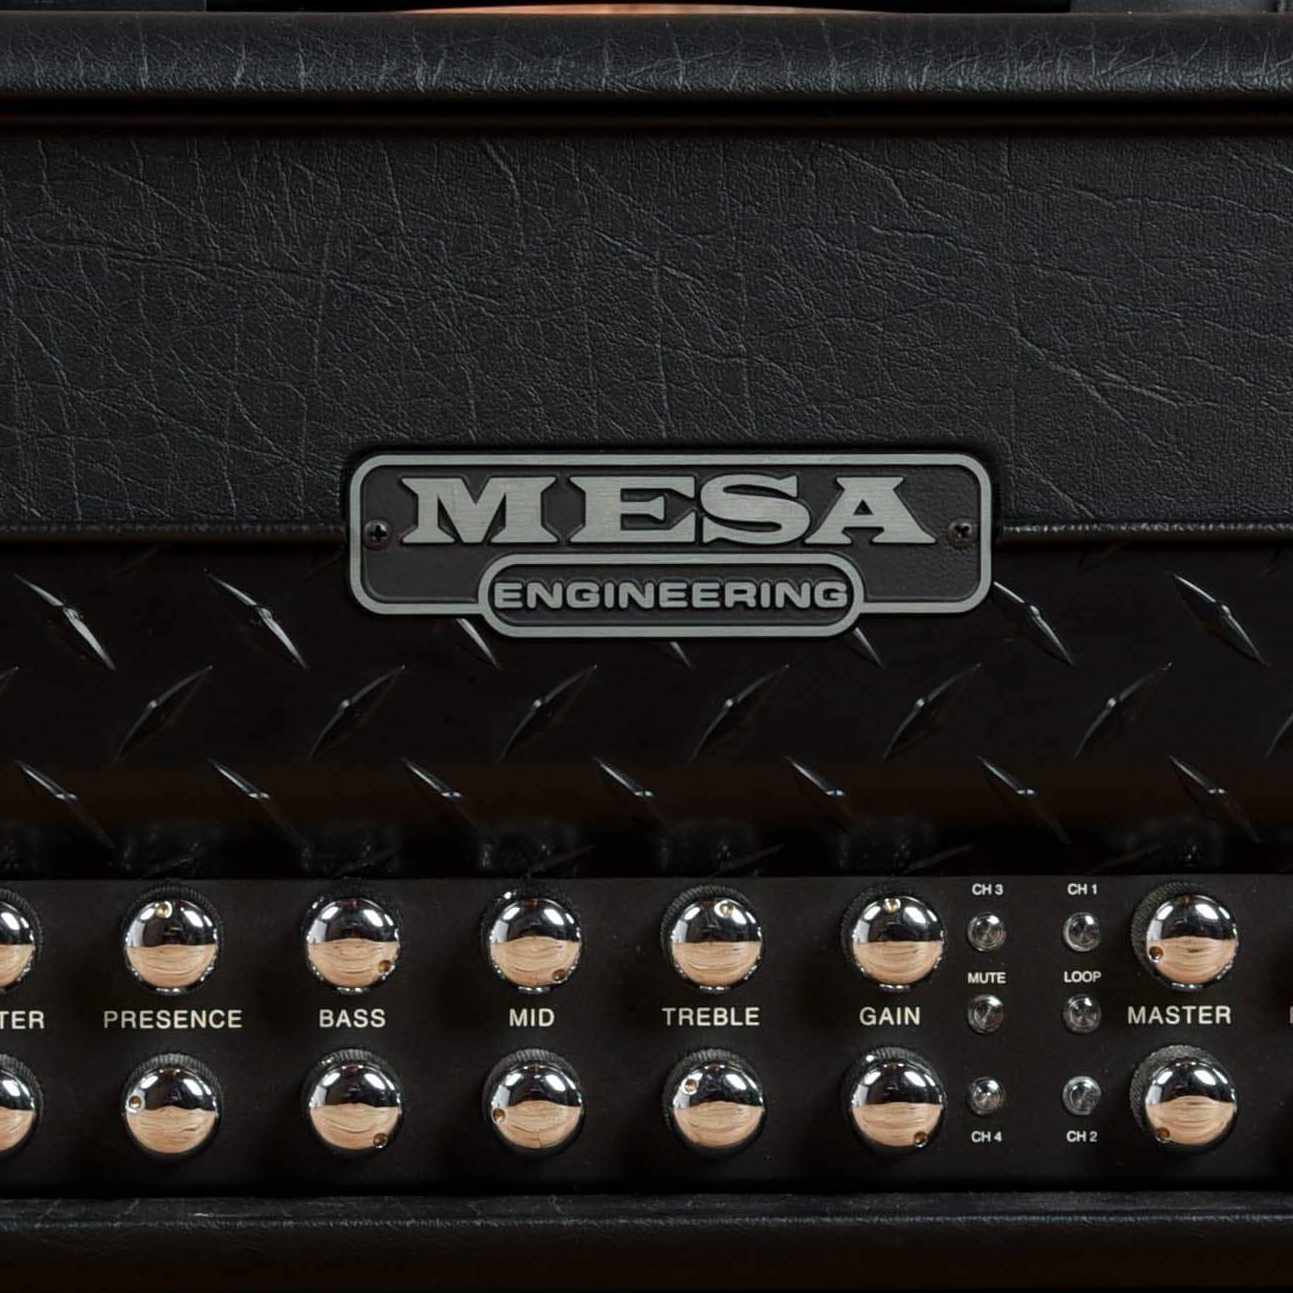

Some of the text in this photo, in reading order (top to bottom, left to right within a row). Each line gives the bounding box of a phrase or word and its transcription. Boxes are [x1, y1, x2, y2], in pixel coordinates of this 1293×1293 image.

[400, 473, 937, 546] MESA
[492, 580, 848, 609] ENGINEERING
[971, 882, 1004, 896] CH 3
[1067, 882, 1098, 896] CH 1
[967, 971, 1007, 985] MUTE
[1063, 970, 1102, 984] LOOP
[104, 1008, 243, 1030] PRESENCE
[319, 1008, 386, 1029] BASS
[509, 1007, 555, 1028] MID
[661, 1006, 760, 1027] TREBLE
[859, 1006, 921, 1026] GAIN
[1127, 1004, 1232, 1025] MASTER
[970, 1130, 1003, 1143] CH 4
[1066, 1130, 1099, 1143] CH 2
